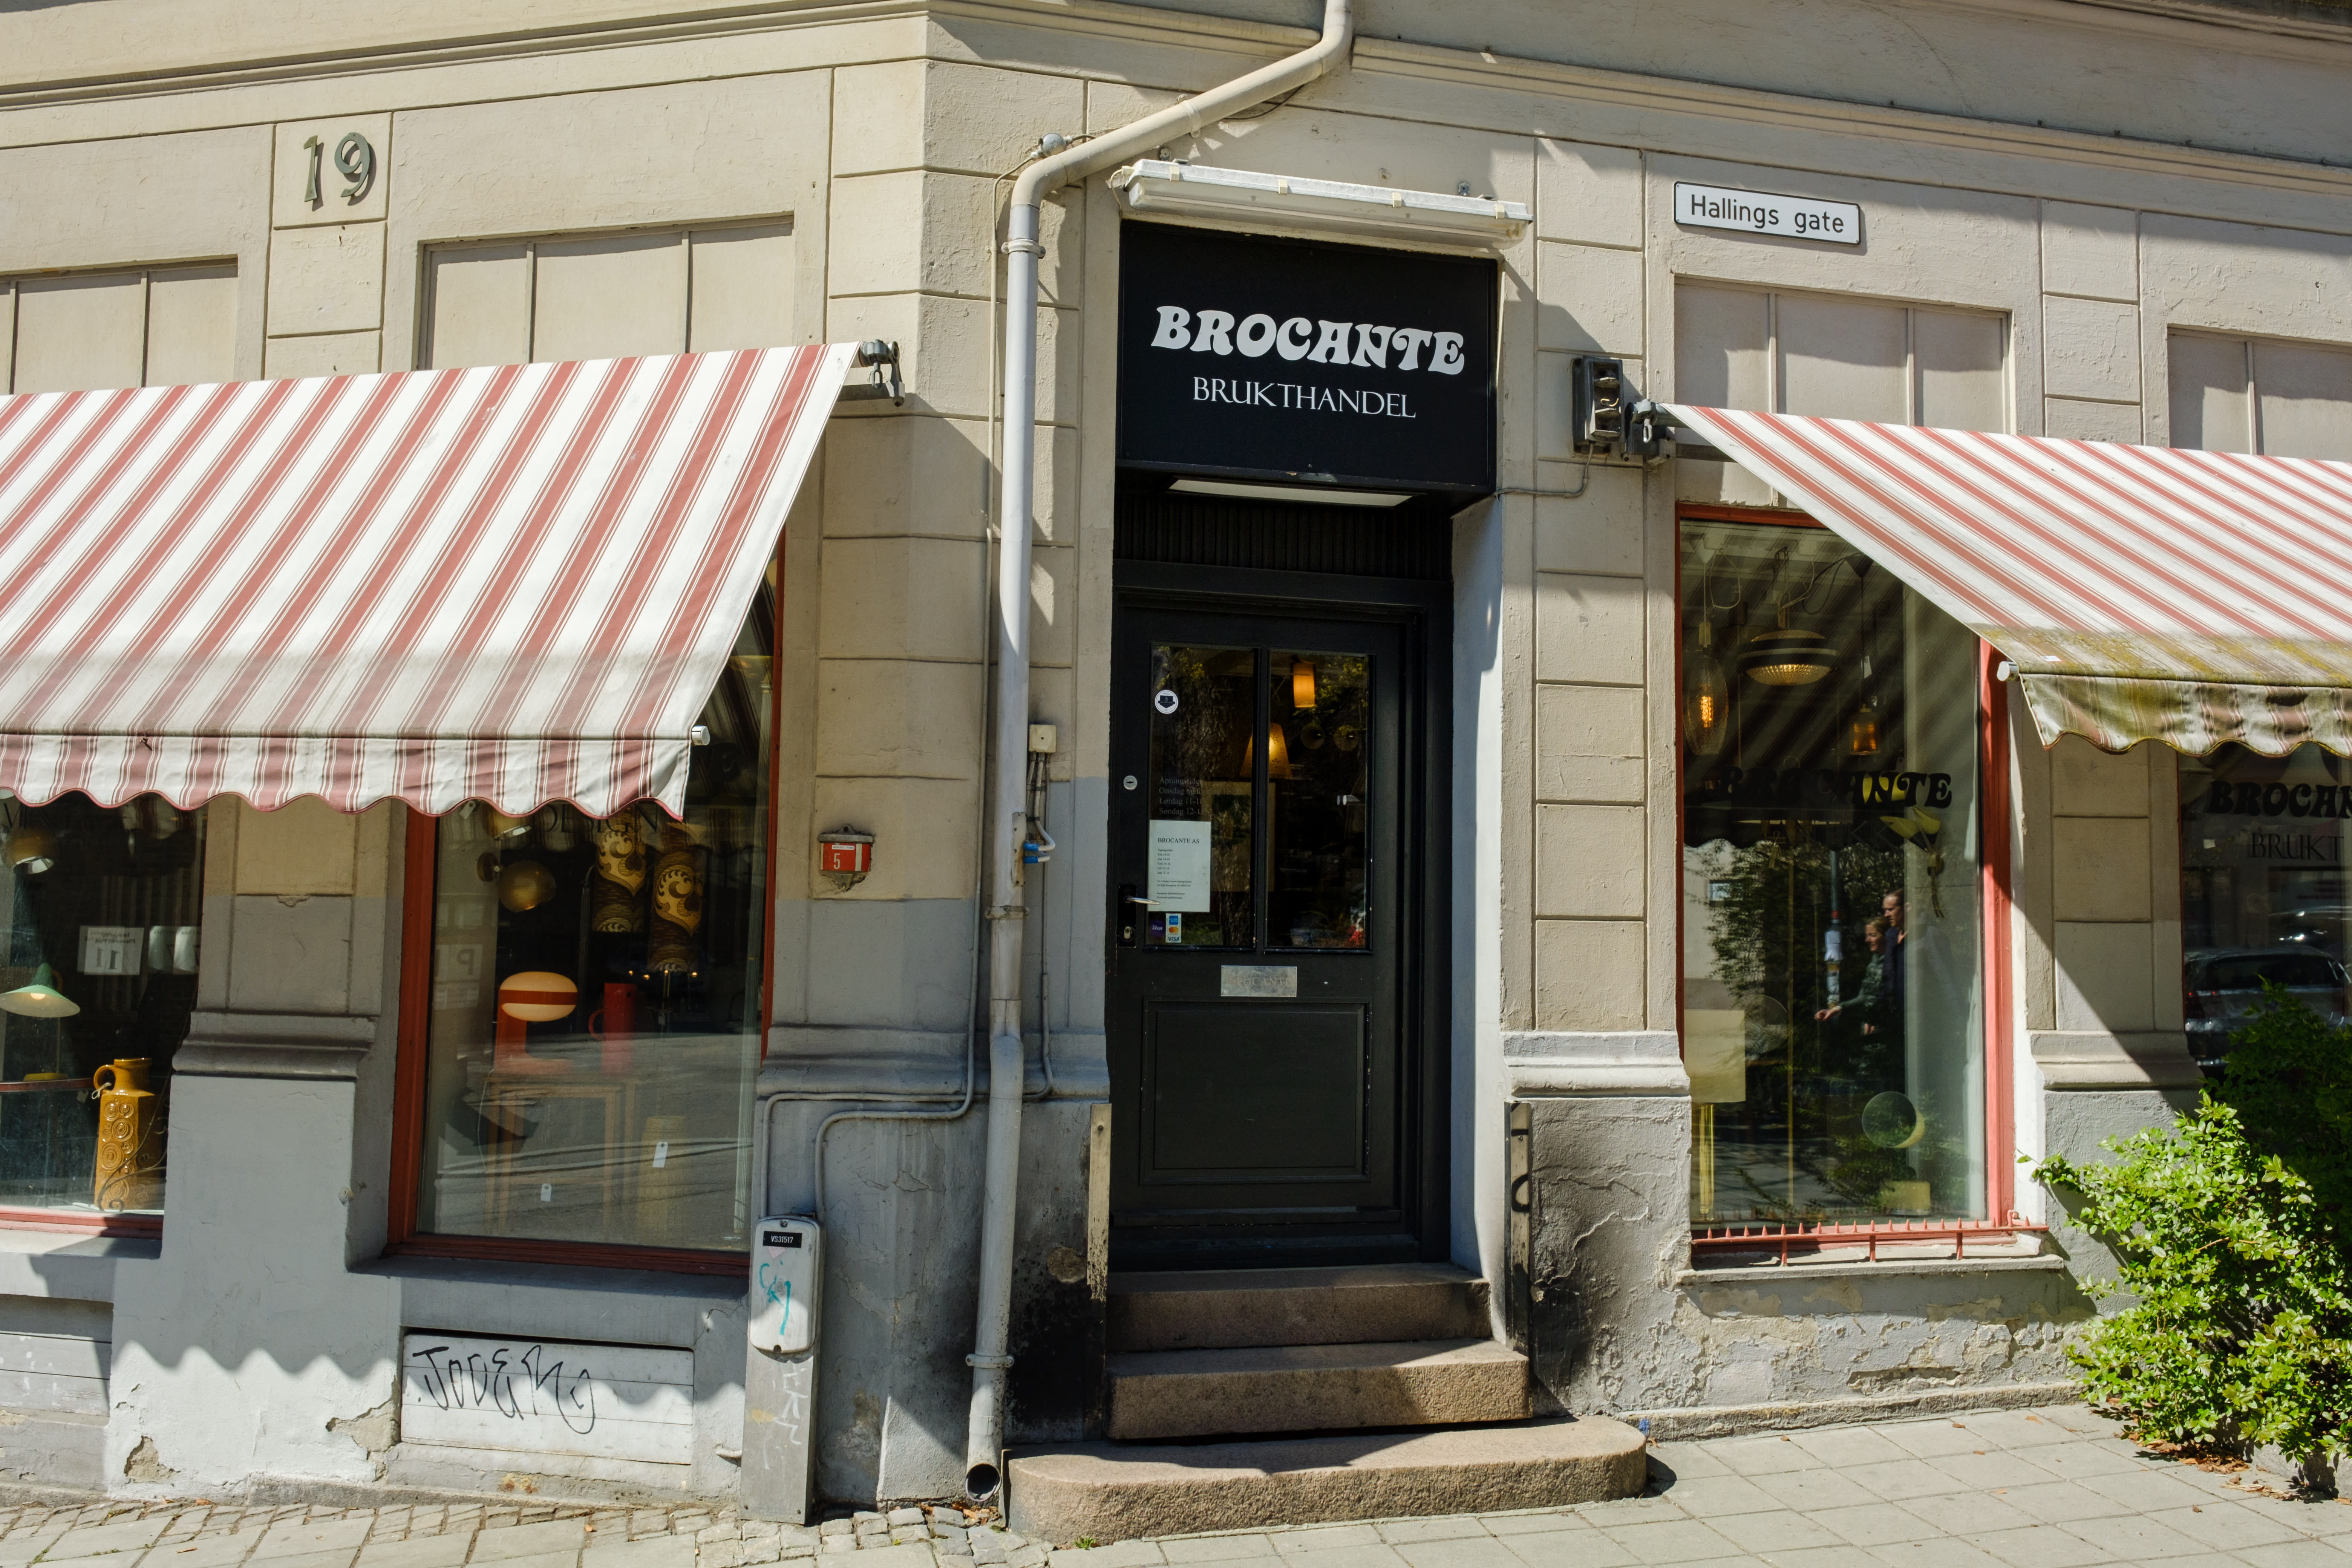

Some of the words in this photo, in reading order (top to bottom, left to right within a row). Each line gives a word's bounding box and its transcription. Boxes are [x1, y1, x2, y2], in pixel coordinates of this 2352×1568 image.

[303, 132, 370, 202] 19
[1691, 194, 1779, 228] Hallings
[1795, 211, 1844, 233] gate
[1151, 306, 1464, 375] BROCANTE
[1193, 377, 1416, 418] BRUKTHANDEL
[1159, 787, 1184, 795] Onsdag
[1159, 808, 1184, 816] Søndag
[833, 853, 841, 869] 5
[771, 1235, 793, 1243] VS31517
